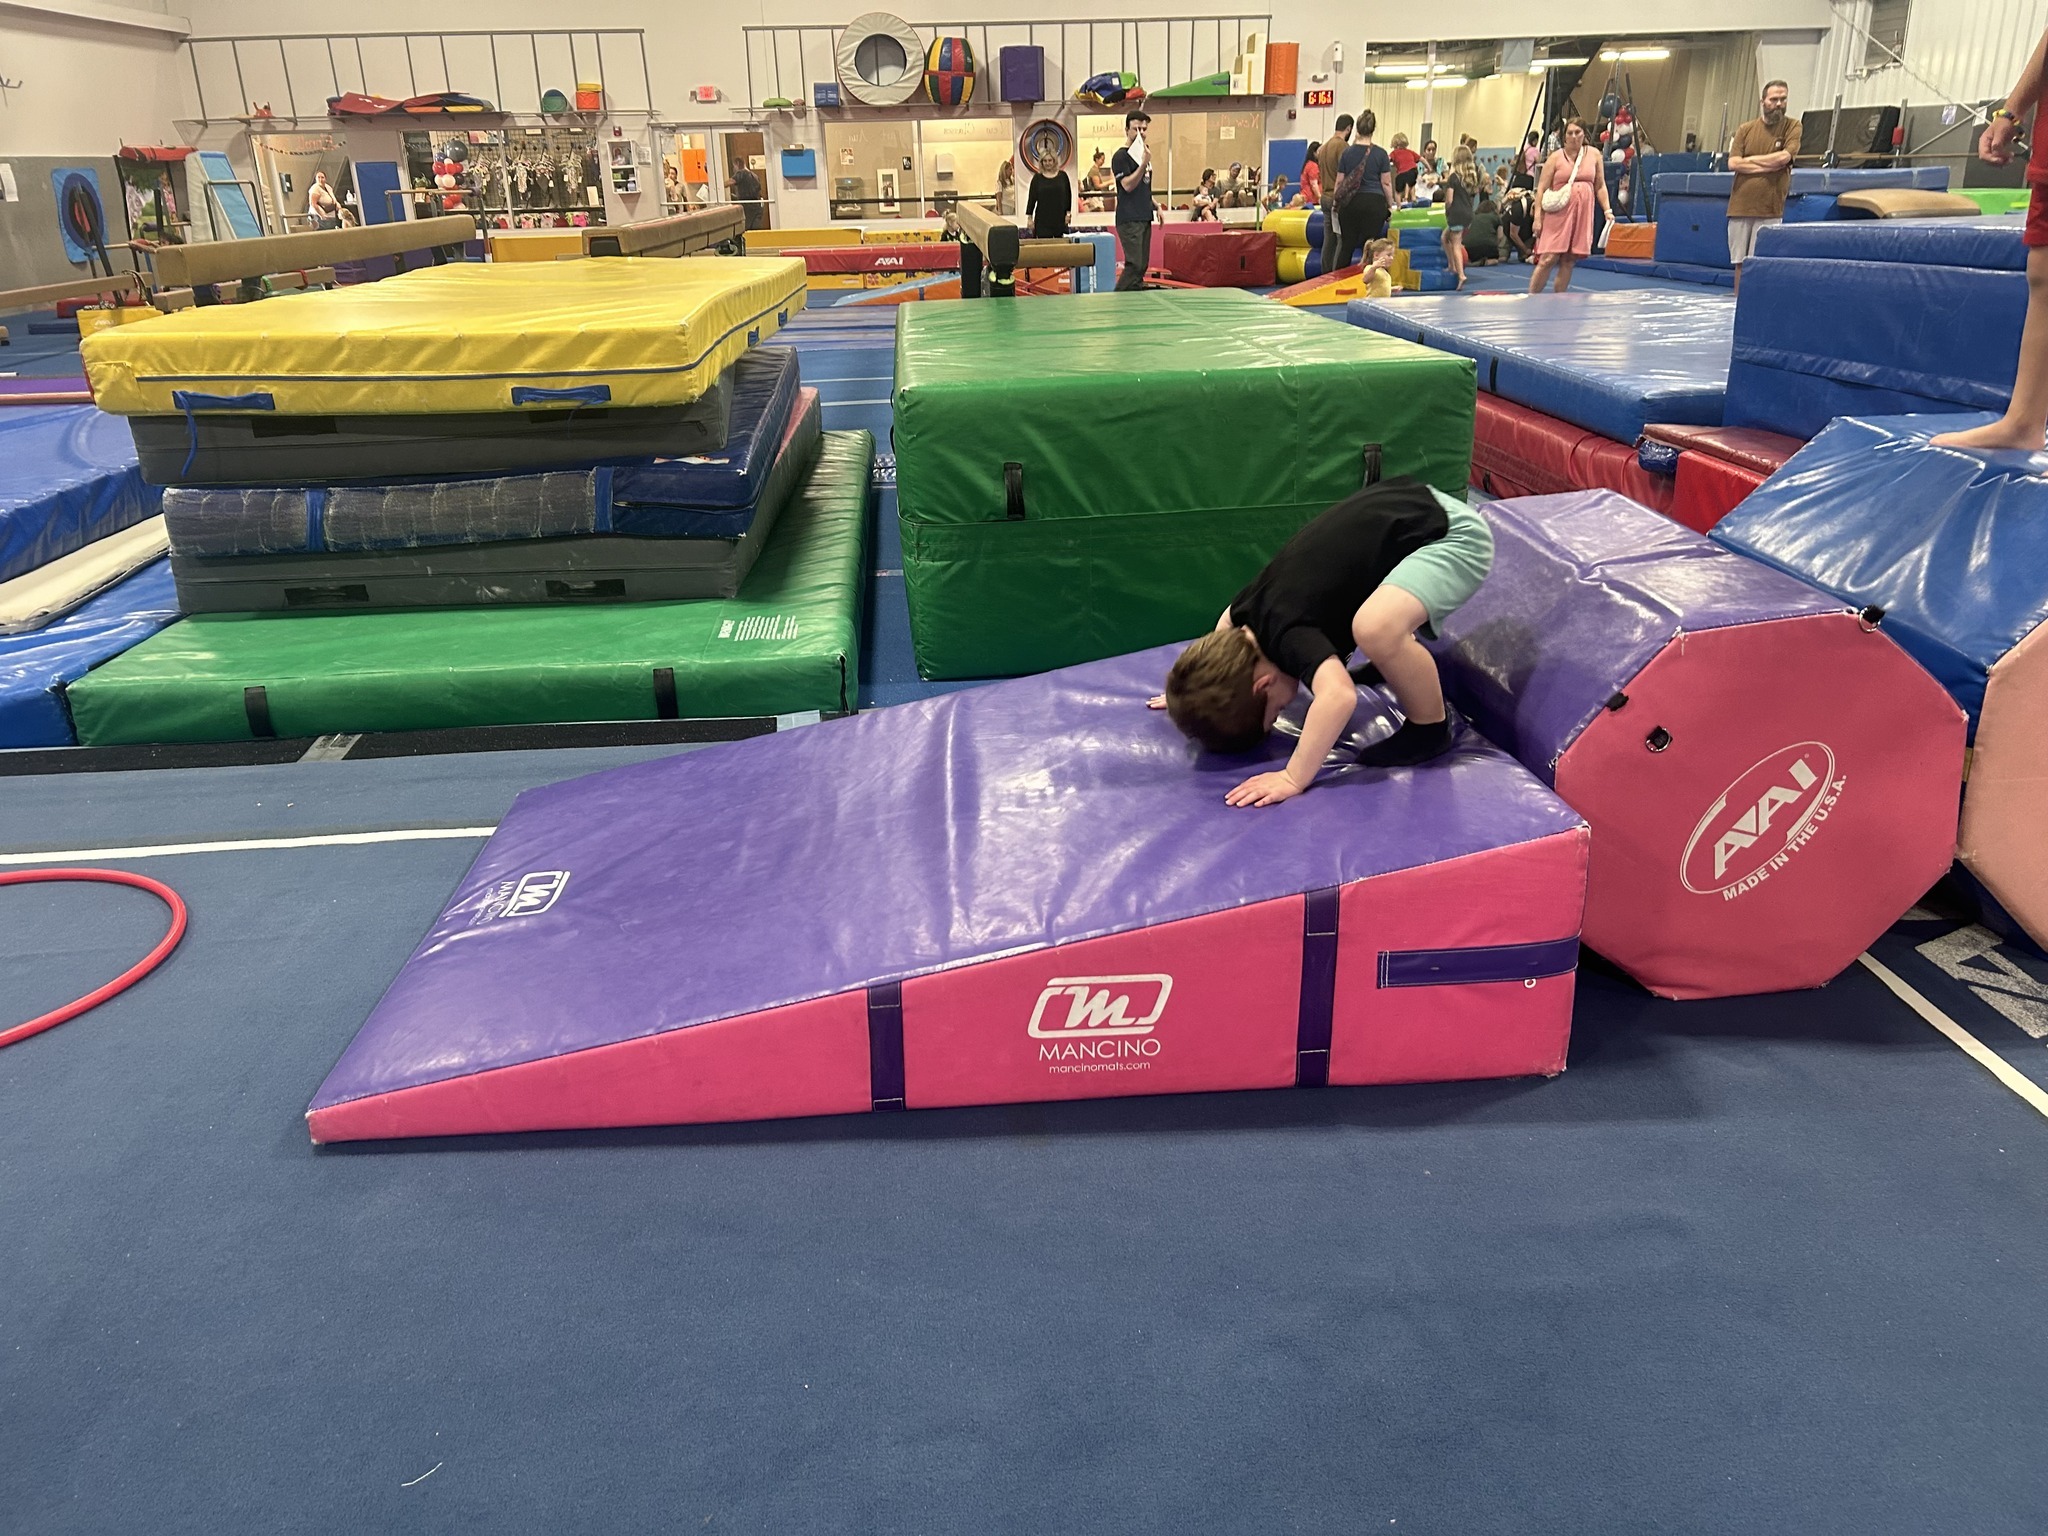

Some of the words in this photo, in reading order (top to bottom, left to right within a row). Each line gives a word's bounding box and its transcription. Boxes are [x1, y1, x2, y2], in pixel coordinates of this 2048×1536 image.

[1722, 867, 1770, 902] MADE
[1769, 852, 1790, 871] IN
[1787, 823, 1819, 853] THE
[1814, 774, 1847, 822] U.S.A.
[1038, 1038, 1162, 1062] MANCINO
[1049, 1061, 1151, 1075] mancinomats.com
